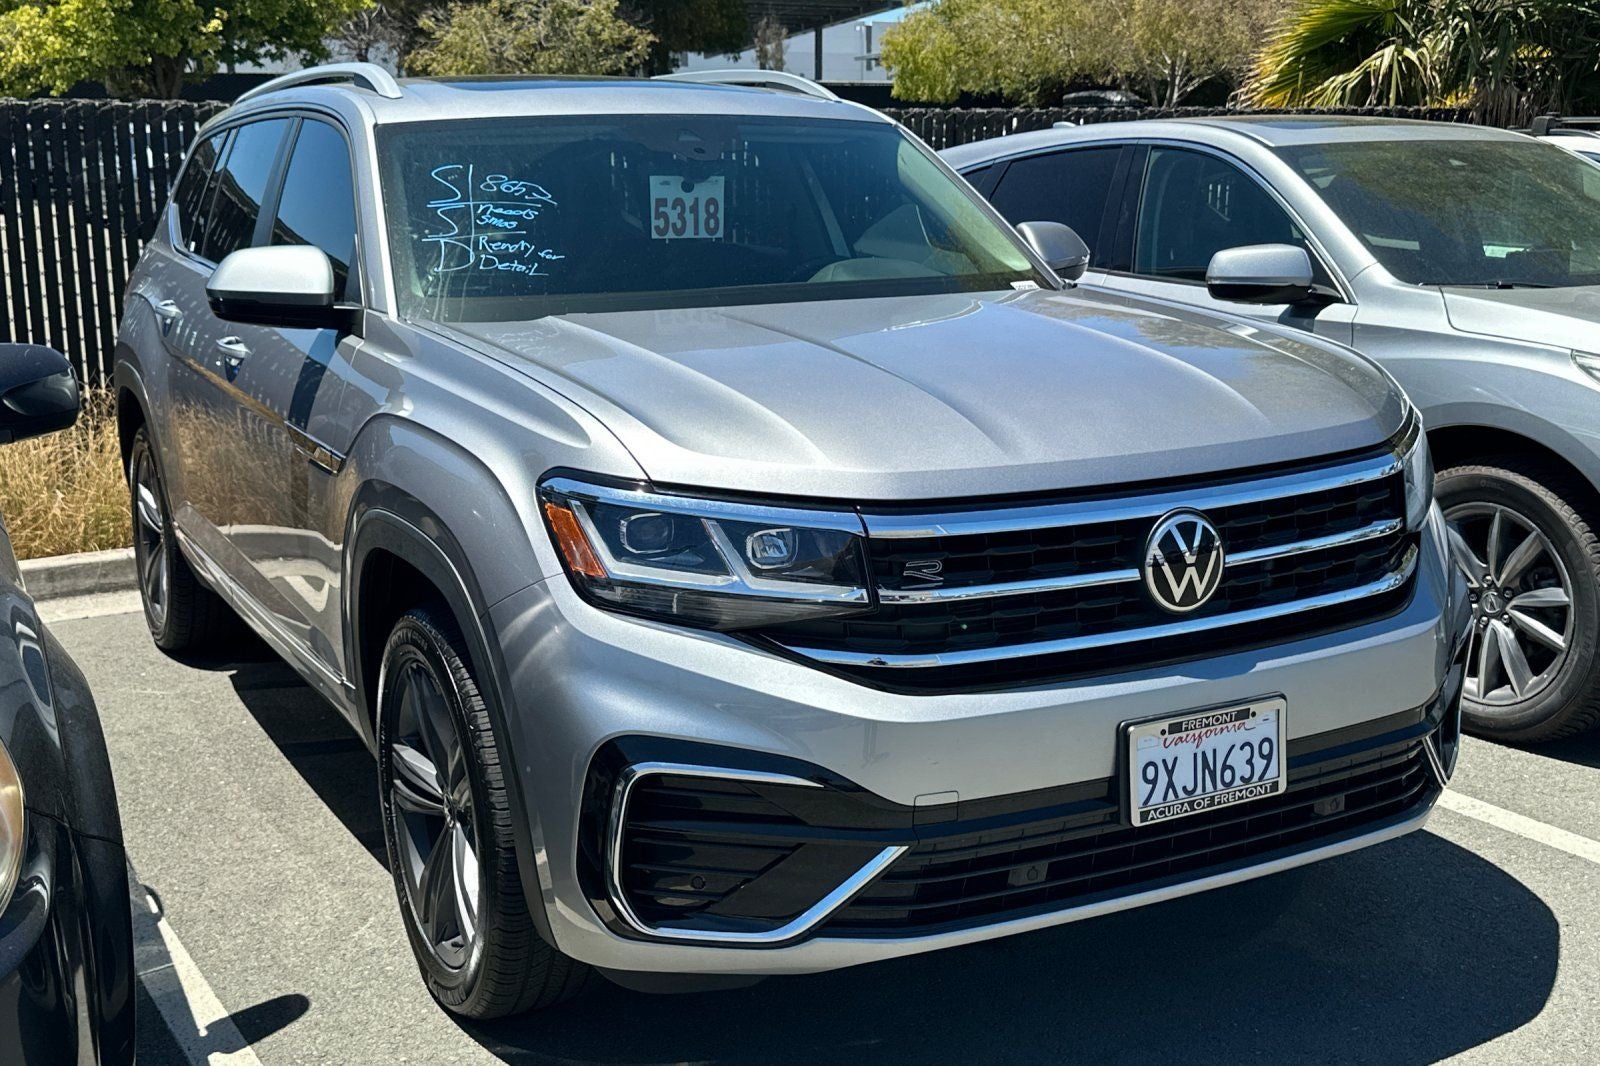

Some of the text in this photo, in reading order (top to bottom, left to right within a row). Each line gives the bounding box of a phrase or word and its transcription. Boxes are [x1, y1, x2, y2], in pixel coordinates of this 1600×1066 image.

[653, 196, 720, 237] 5318
[479, 235, 535, 258] Ready
[1181, 711, 1238, 732] FREMONT
[1141, 736, 1274, 807] 9XJN639
[1147, 783, 1273, 821] ACURA OF FREMONT
